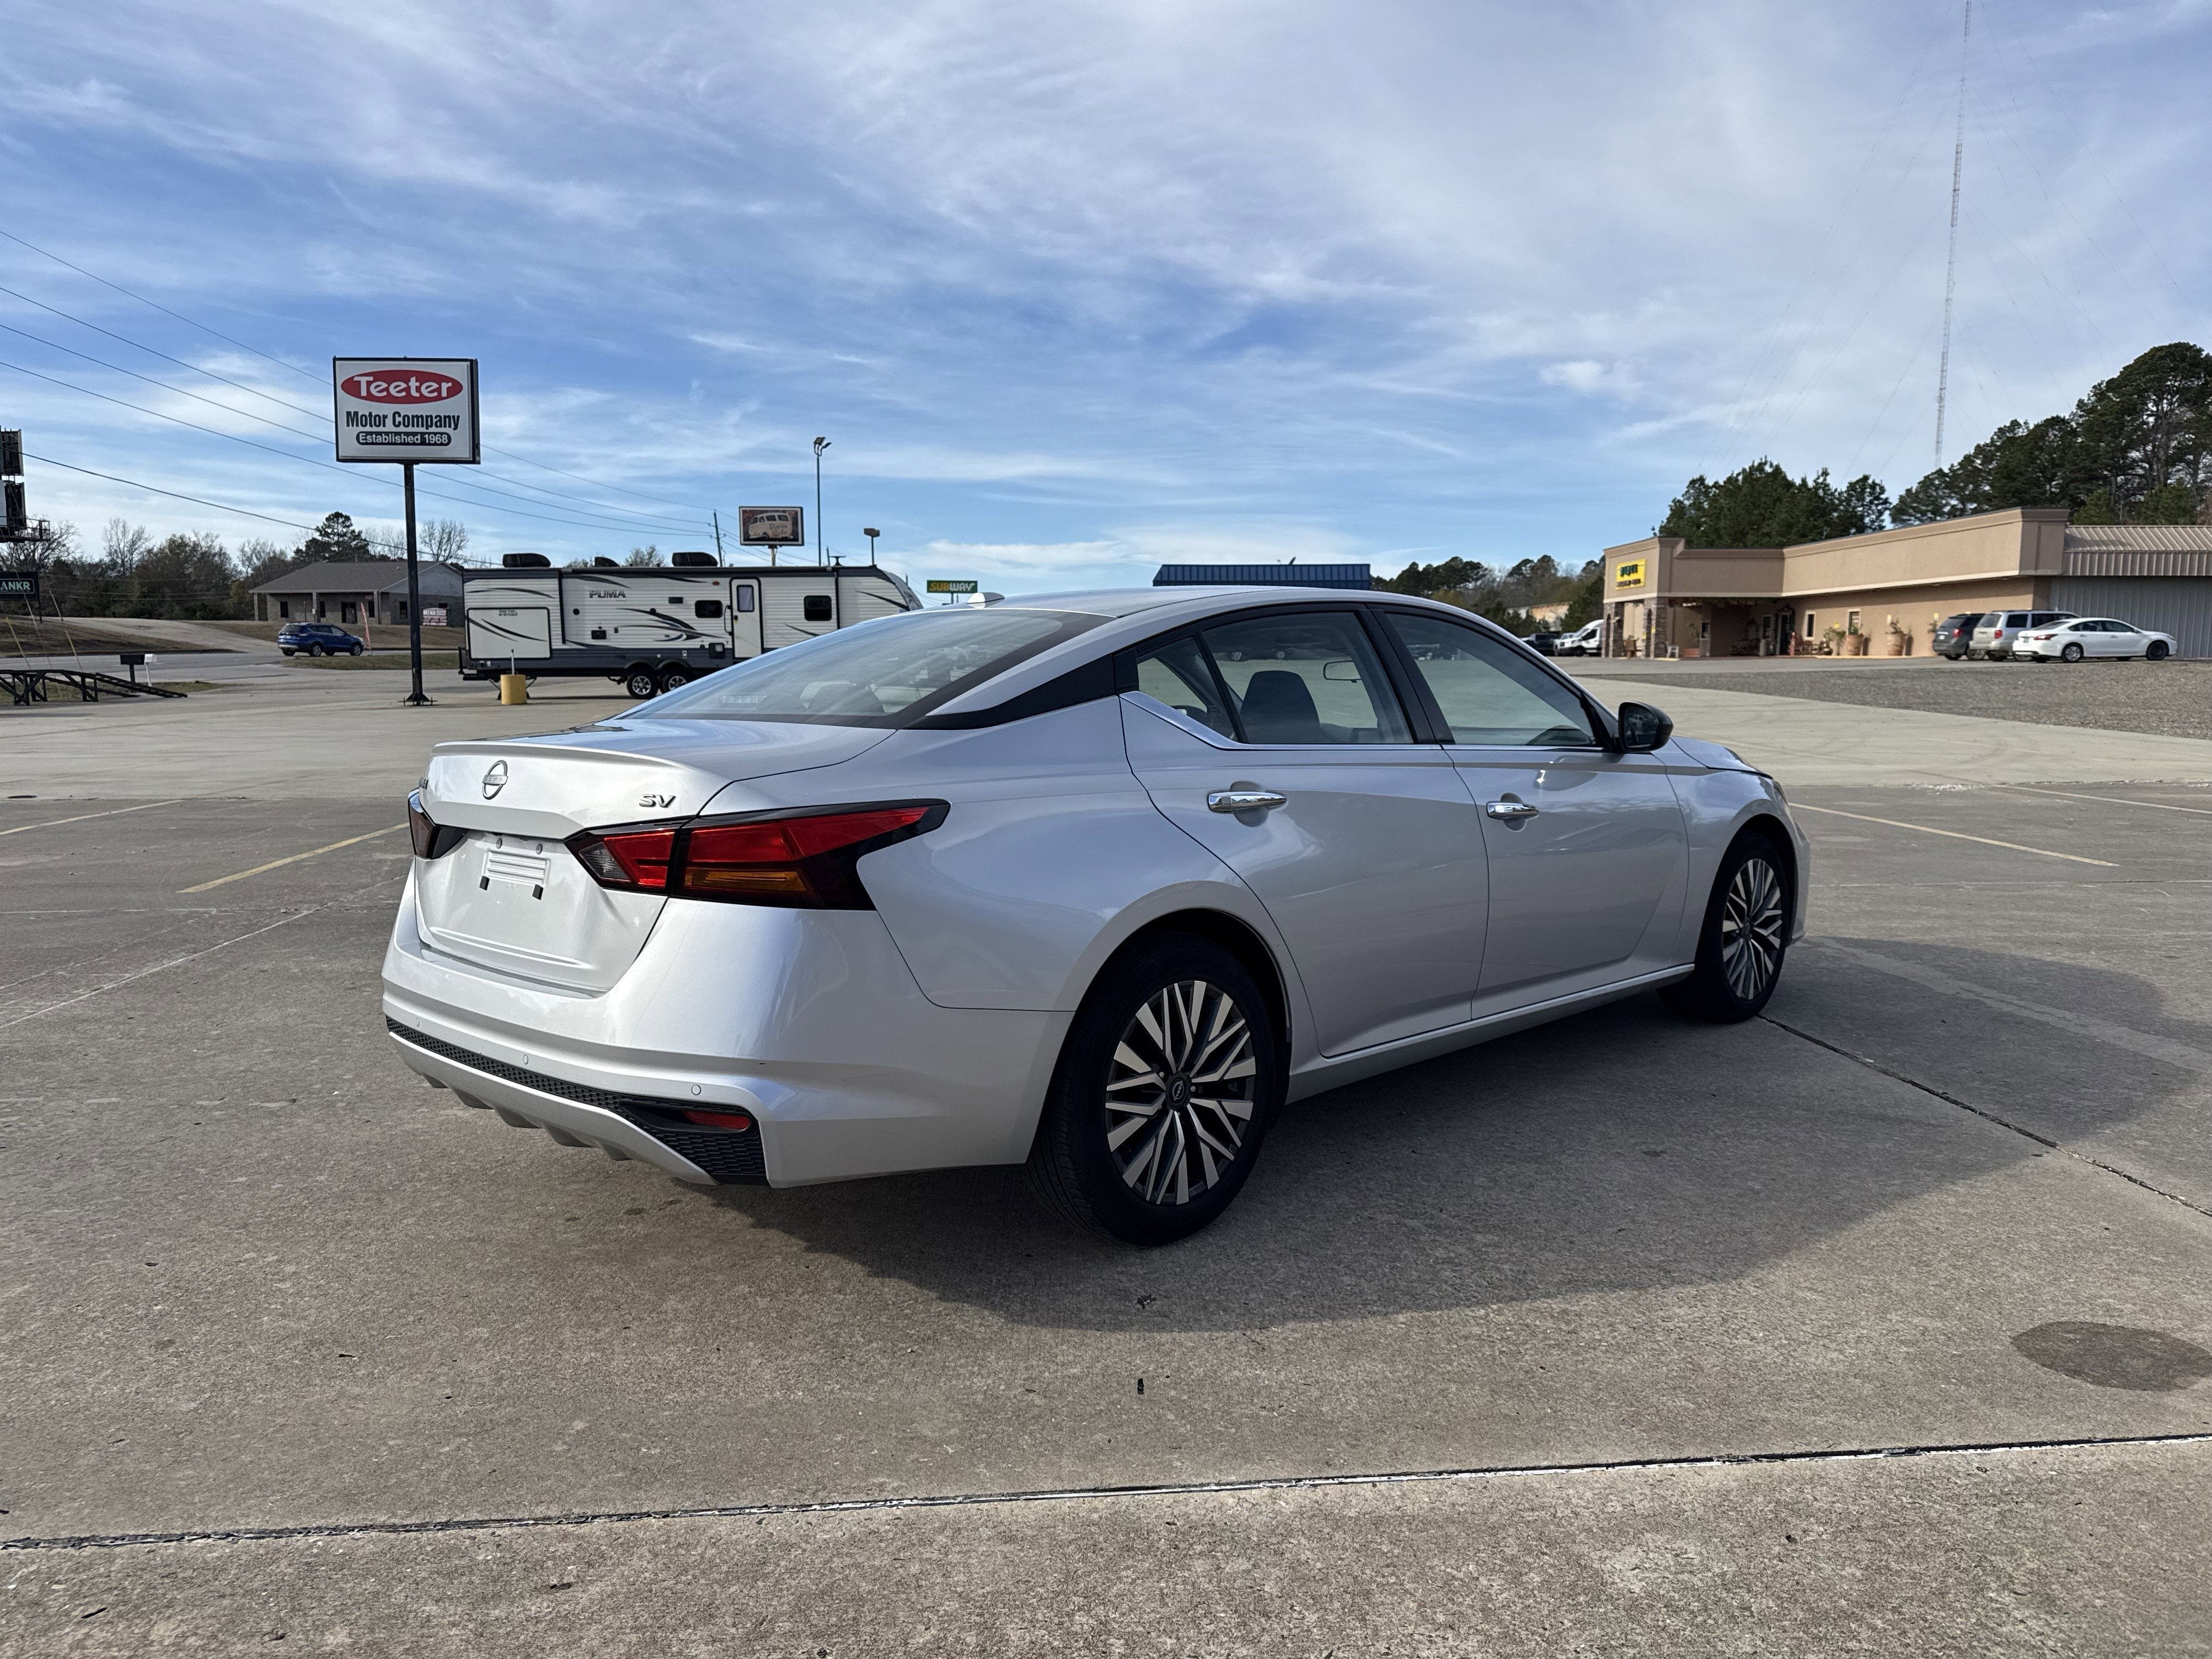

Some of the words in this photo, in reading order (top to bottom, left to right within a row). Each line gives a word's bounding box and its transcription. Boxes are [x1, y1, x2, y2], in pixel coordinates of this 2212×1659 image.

[353, 376, 452, 398] Teeter
[346, 411, 388, 428] Motor
[392, 411, 460, 430] Company
[359, 433, 421, 443] Established
[424, 433, 448, 444] 1968
[929, 582, 976, 591] SUBWAY
[589, 590, 627, 599] PUMA
[639, 794, 676, 808] SV
